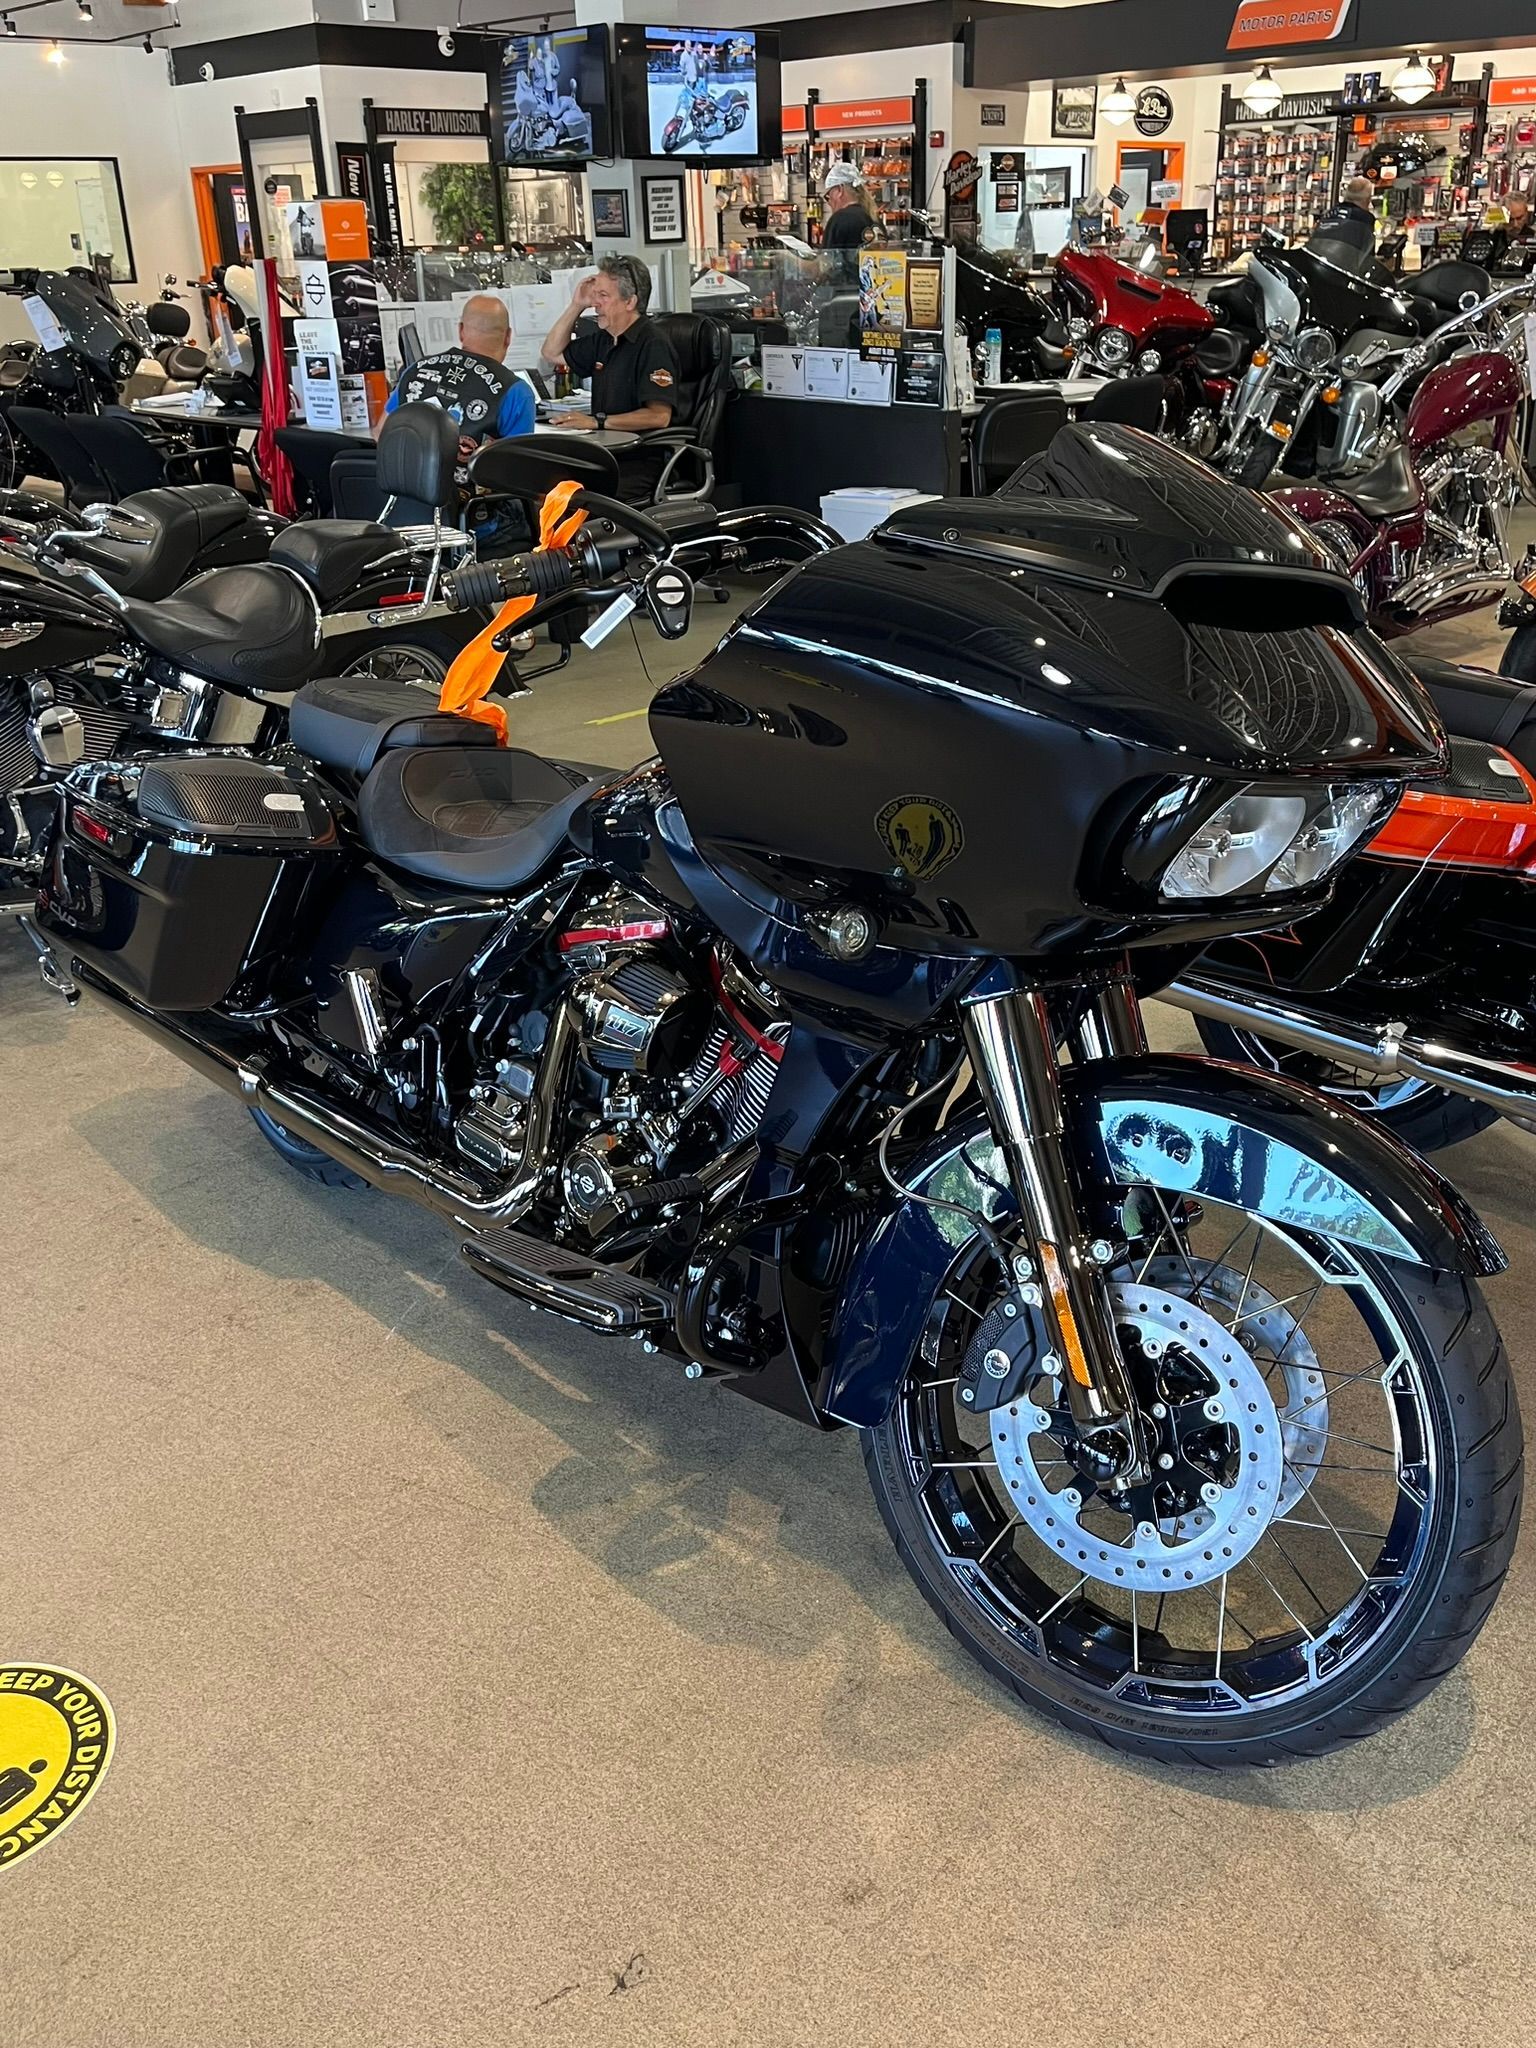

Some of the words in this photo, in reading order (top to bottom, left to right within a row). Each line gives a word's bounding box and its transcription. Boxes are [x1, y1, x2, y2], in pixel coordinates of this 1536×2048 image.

[1239, 15, 1285, 32] MOTOR
[1288, 9, 1333, 27] PARTS
[385, 110, 481, 133] HARLEY-DAVIDSON
[855, 109, 882, 117] PRODUCTS
[347, 158, 360, 196] New
[383, 163, 392, 184] NEW
[388, 208, 399, 232] SAME
[417, 354, 503, 395] PORTUGAL
[607, 1015, 644, 1037] 117
[0, 1671, 55, 1692] EEP
[53, 1681, 102, 1742] YOUR
[0, 1744, 102, 1858] DISTANC
